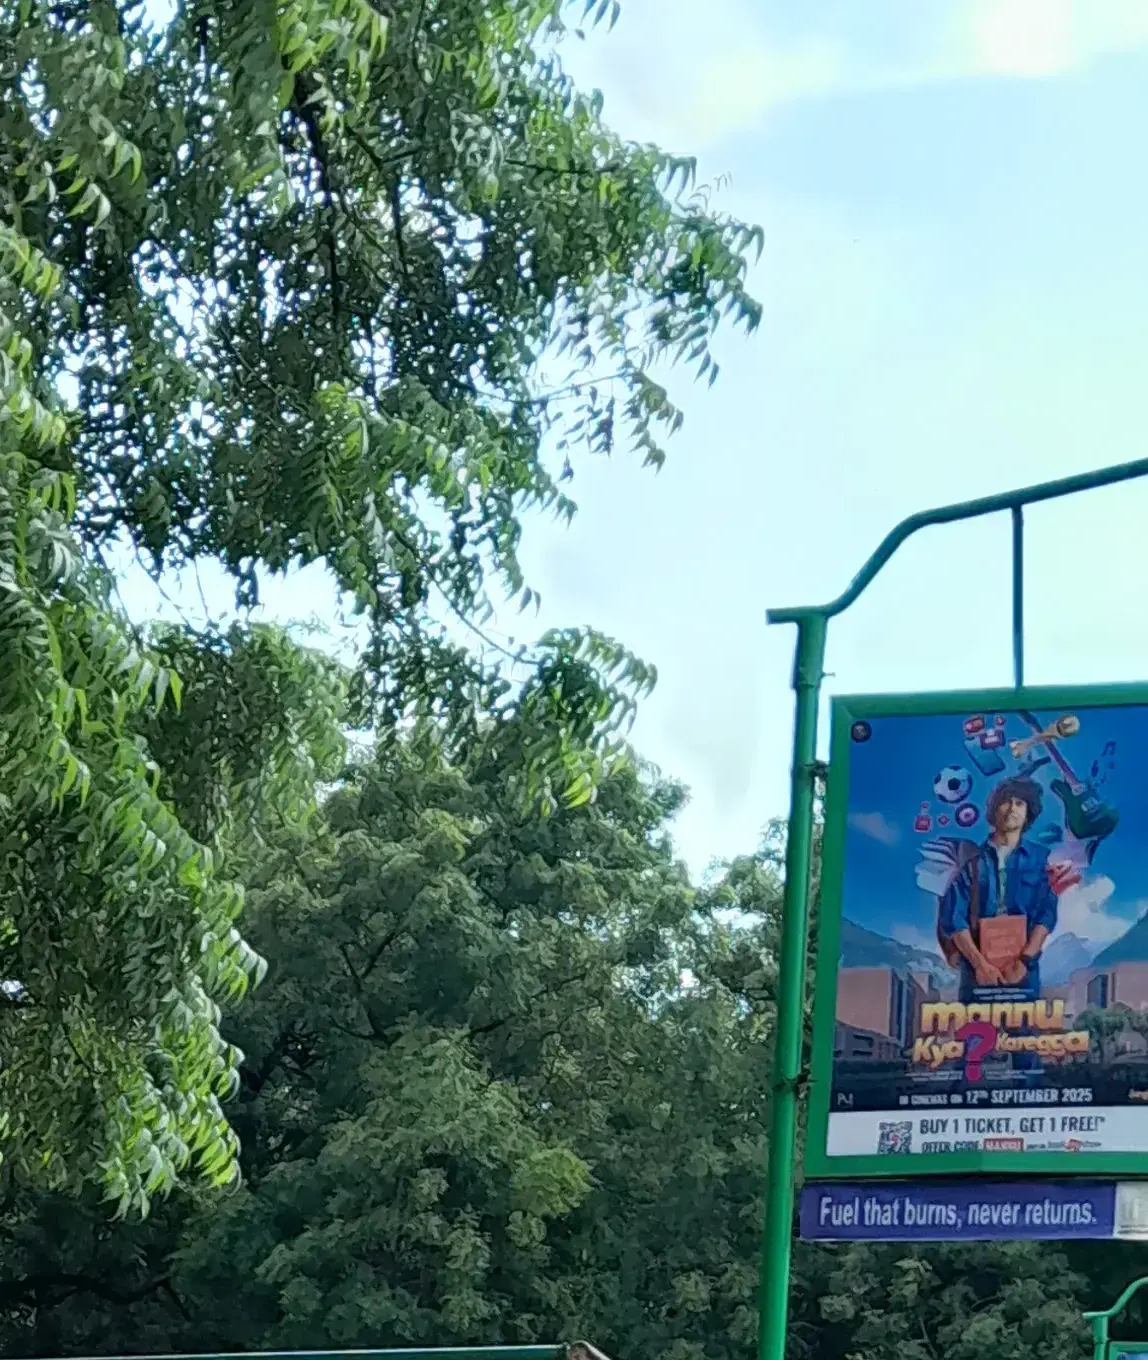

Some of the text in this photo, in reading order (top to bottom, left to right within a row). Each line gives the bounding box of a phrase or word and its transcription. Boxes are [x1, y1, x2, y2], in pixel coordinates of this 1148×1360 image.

[990, 1089, 1059, 1104] SEPTEMBER
[1061, 1088, 1092, 1102] 2025
[920, 1118, 949, 1134] BUY
[953, 1118, 959, 1133] 1
[964, 1117, 1015, 1135] TICKET,
[1019, 1117, 1045, 1133] GET
[1050, 1117, 1056, 1132] 1
[819, 1196, 1097, 1231] Fuel that burns, never returns.
